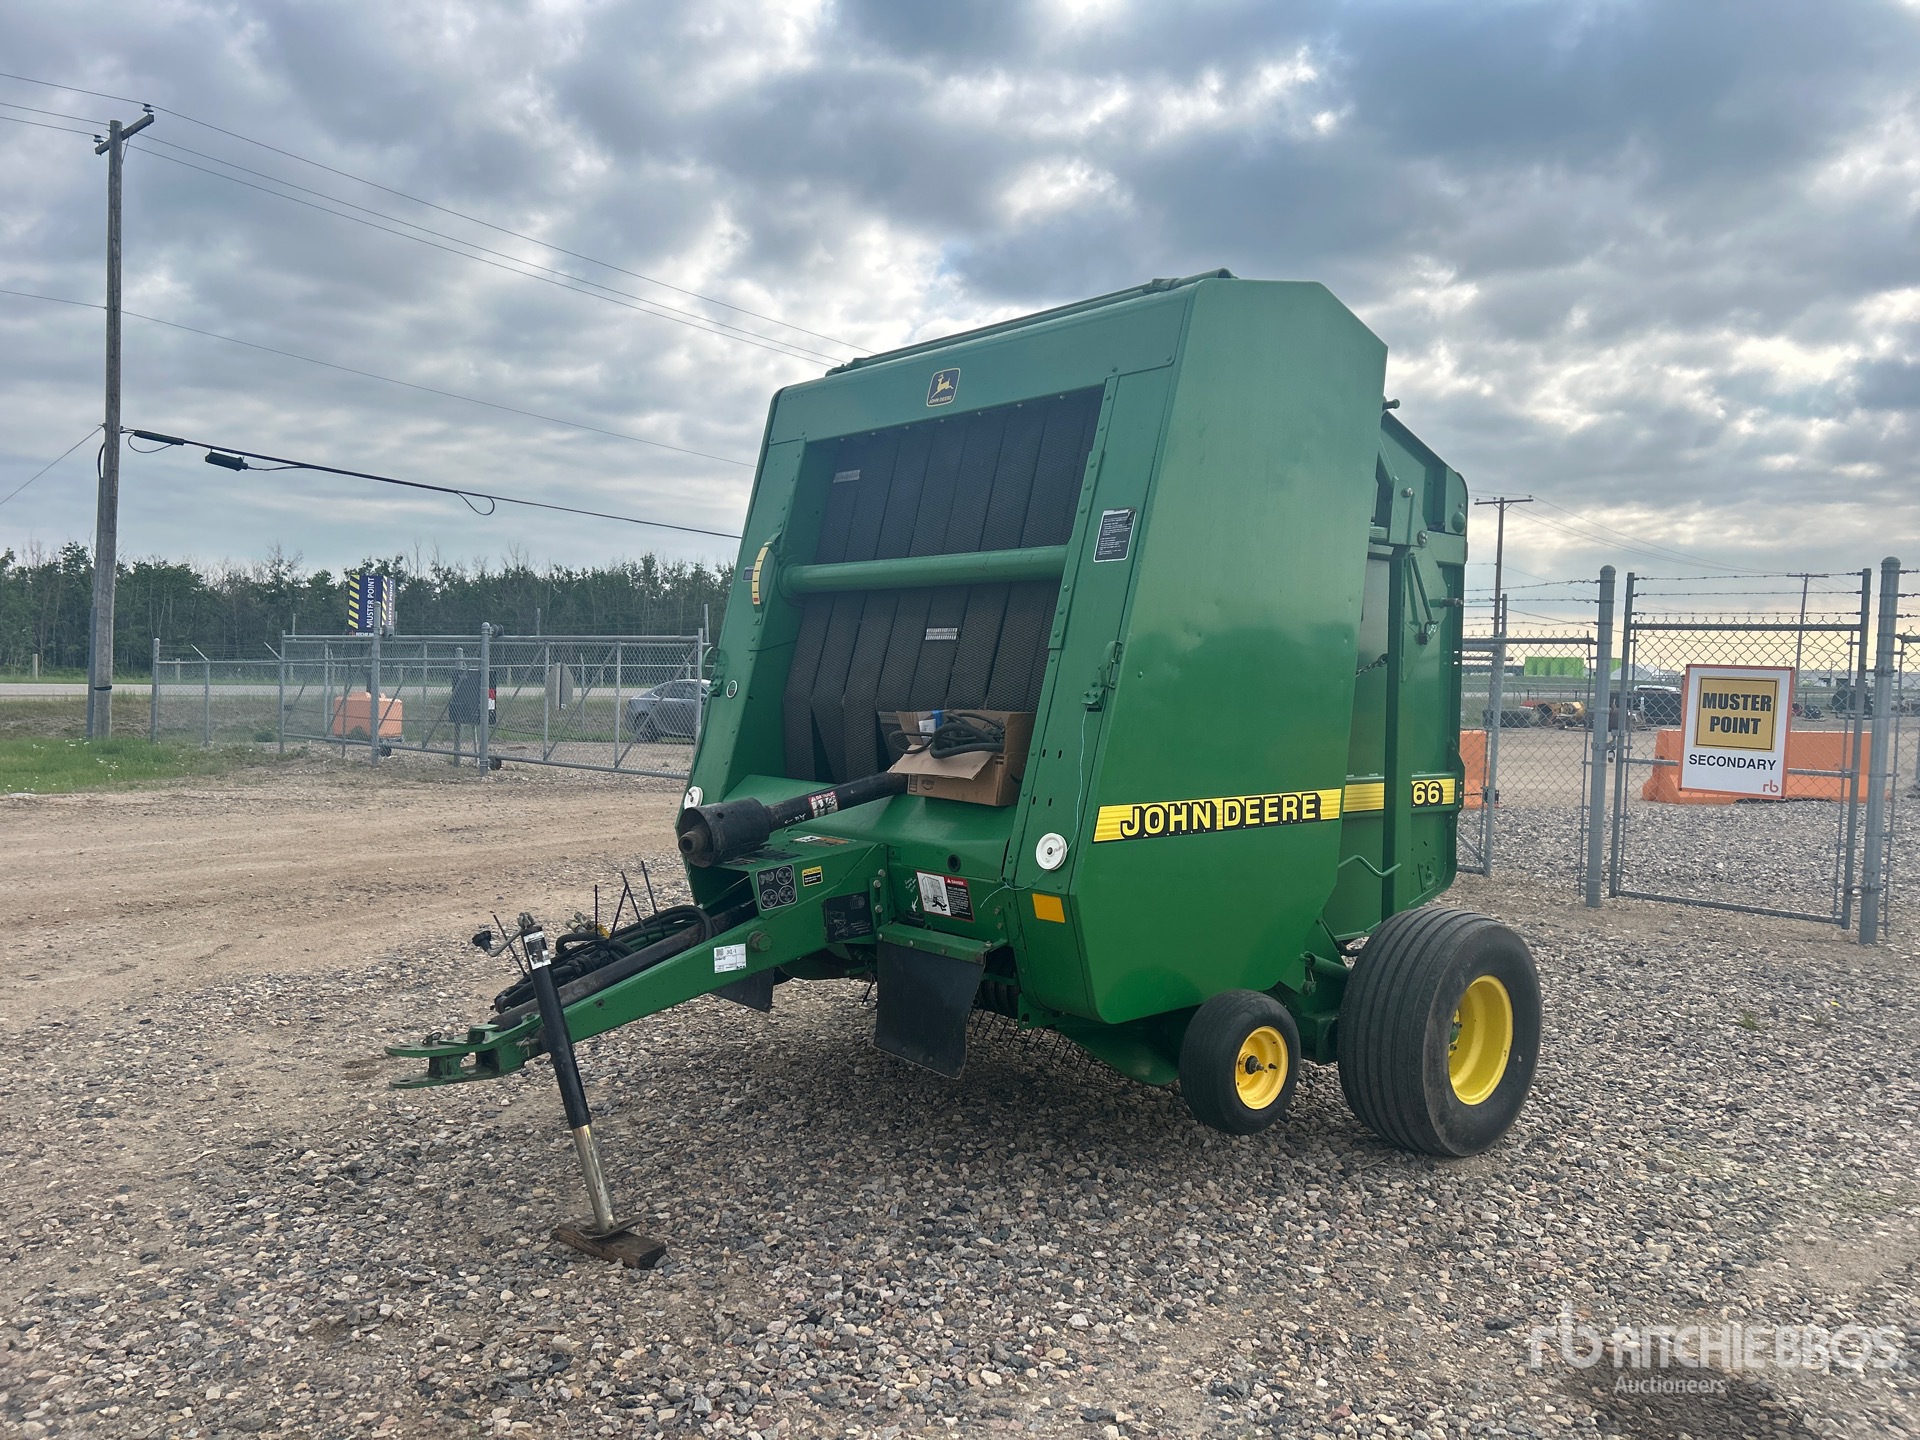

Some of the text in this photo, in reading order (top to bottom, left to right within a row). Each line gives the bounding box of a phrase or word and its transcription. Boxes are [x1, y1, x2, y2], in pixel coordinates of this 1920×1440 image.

[366, 577, 375, 628] MUSTER POINT
[1702, 692, 1772, 712] MUSTER
[1709, 715, 1762, 735] POINT
[1688, 753, 1777, 771] SECONDARY
[1762, 779, 1779, 793] rb
[1121, 793, 1319, 837] JOHN DEERE
